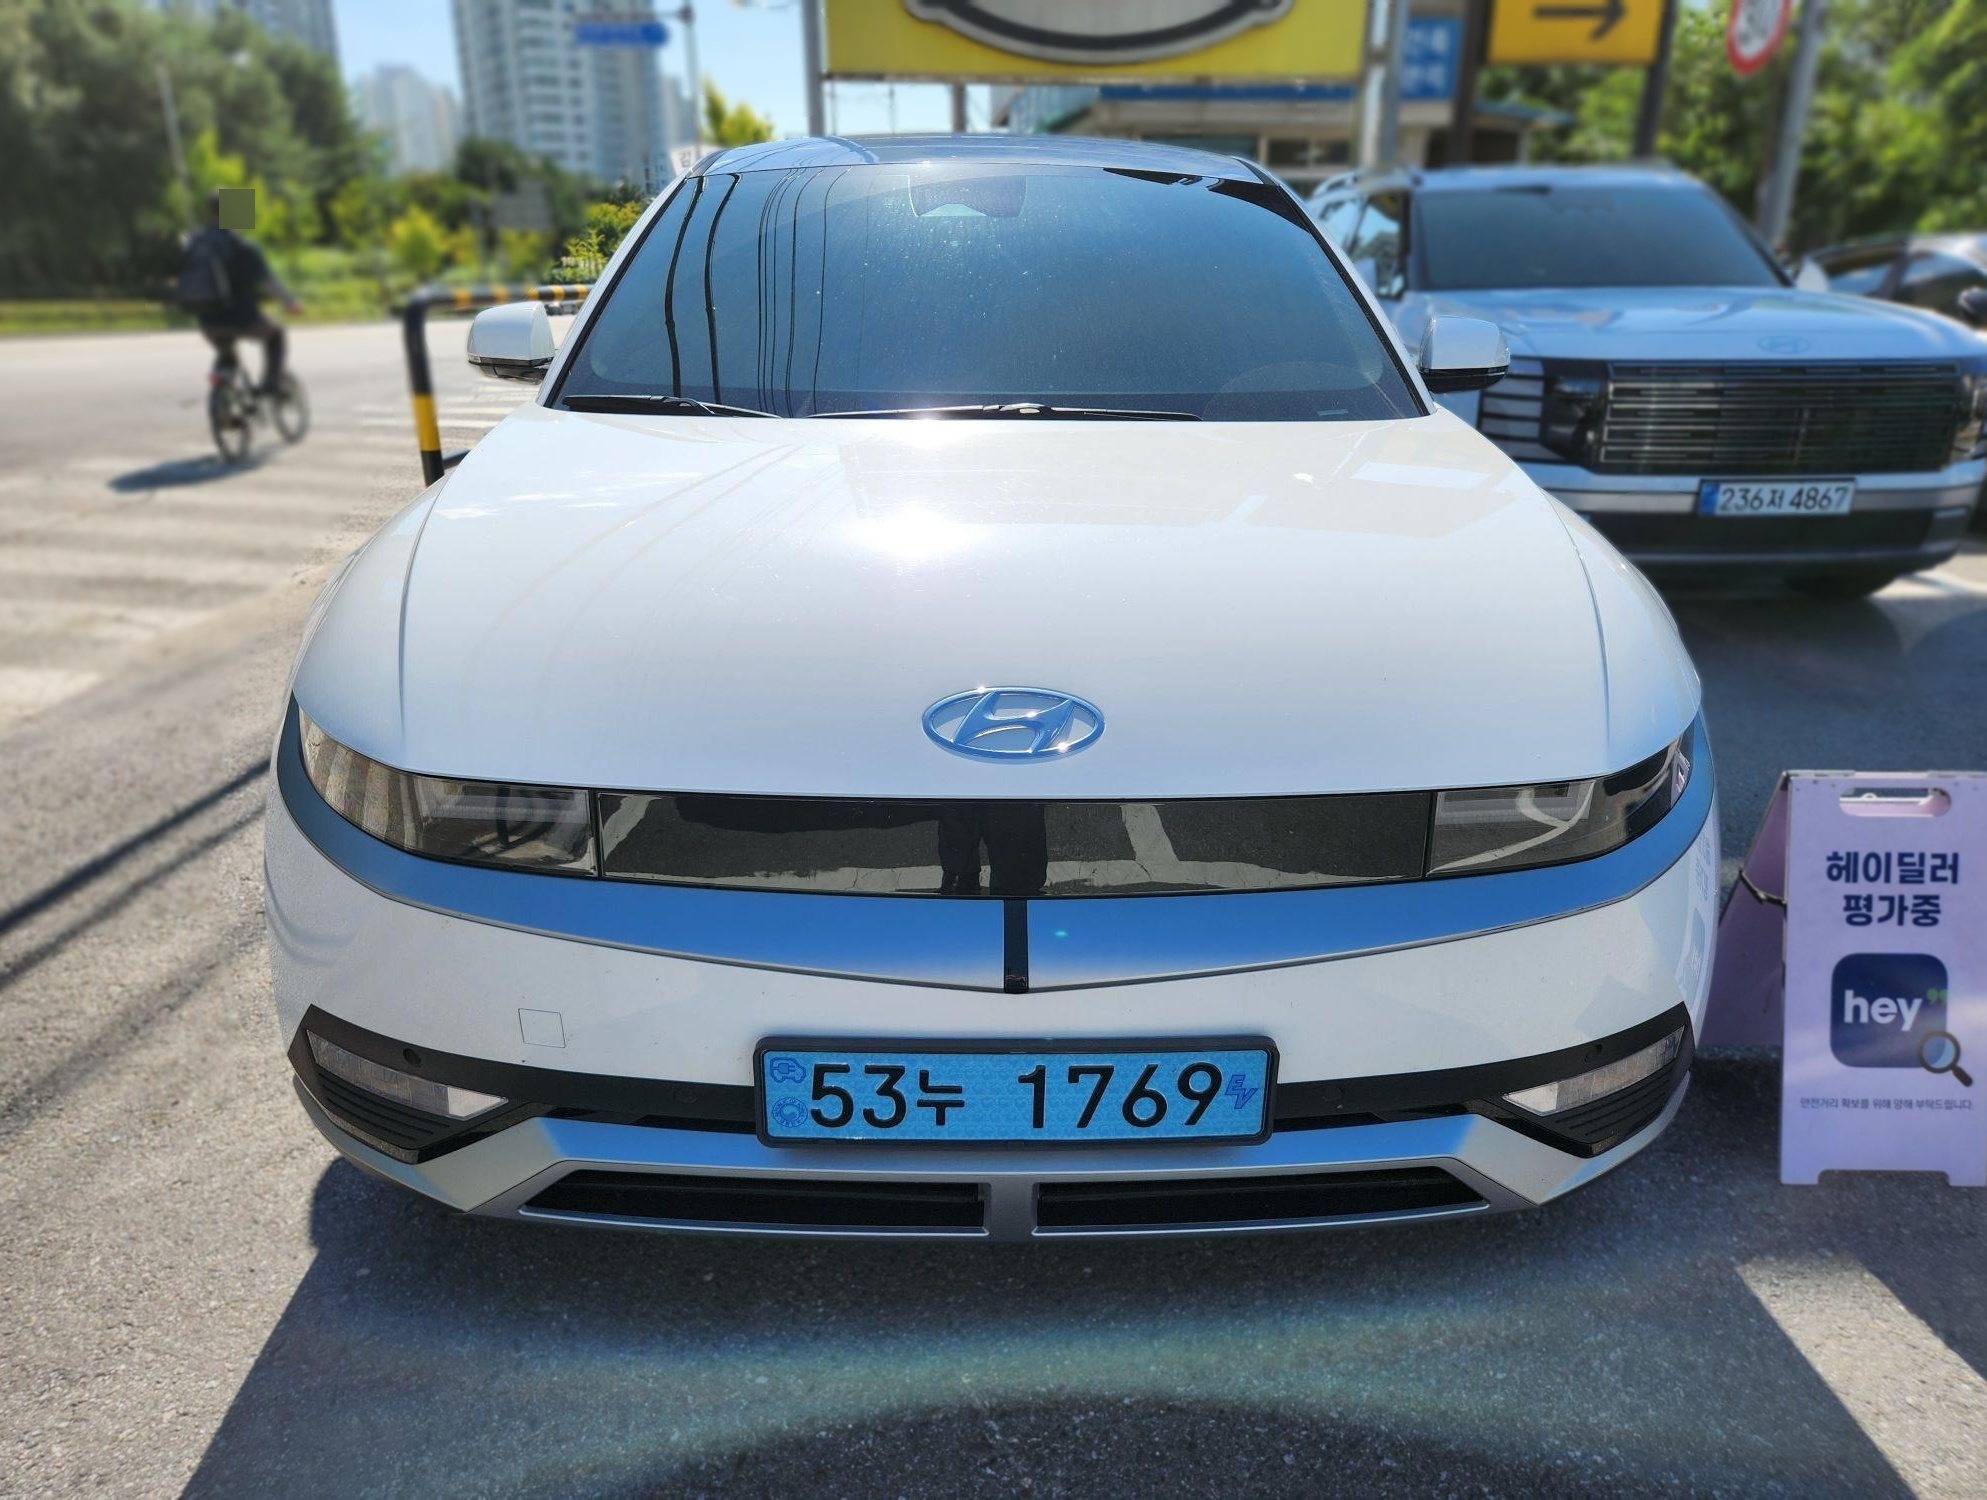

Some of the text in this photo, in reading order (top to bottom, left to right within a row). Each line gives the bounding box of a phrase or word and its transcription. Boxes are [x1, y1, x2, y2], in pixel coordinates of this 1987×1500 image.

[1789, 486, 1849, 510] 4867
[1826, 851, 1959, 884] 헤이딜러
[1843, 894, 1941, 927] 평가중
[1844, 989, 1923, 1032] hey
[810, 1063, 965, 1129] 53누
[1017, 1061, 1223, 1129] 1769
[1224, 1074, 1259, 1110] EV
[1873, 1098, 1891, 1109] 위해
